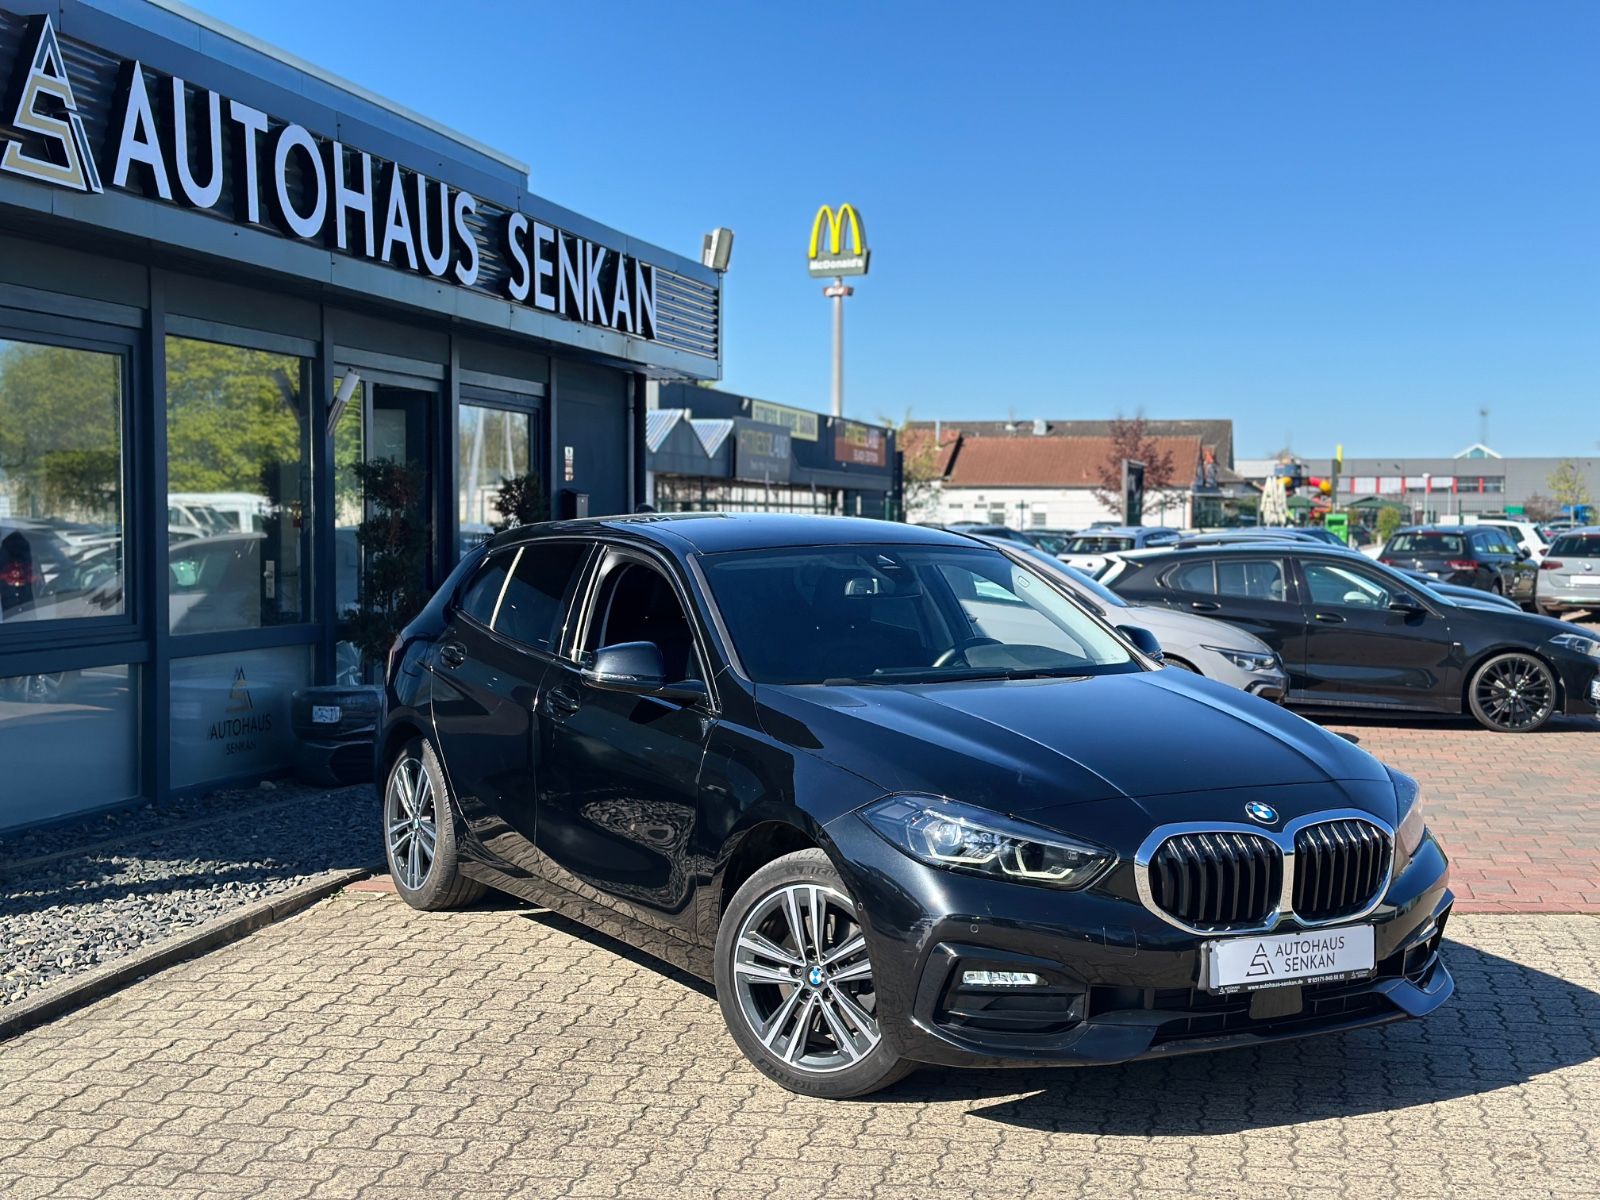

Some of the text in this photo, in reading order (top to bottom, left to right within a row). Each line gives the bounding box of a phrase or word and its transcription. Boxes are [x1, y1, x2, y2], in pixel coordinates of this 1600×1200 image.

[113, 60, 657, 340] AUTOHAUS SENKAN
[209, 713, 272, 740] AUTOHAUS
[1275, 936, 1345, 957] AUTOHAUS
[1284, 952, 1335, 973] SENKAN
